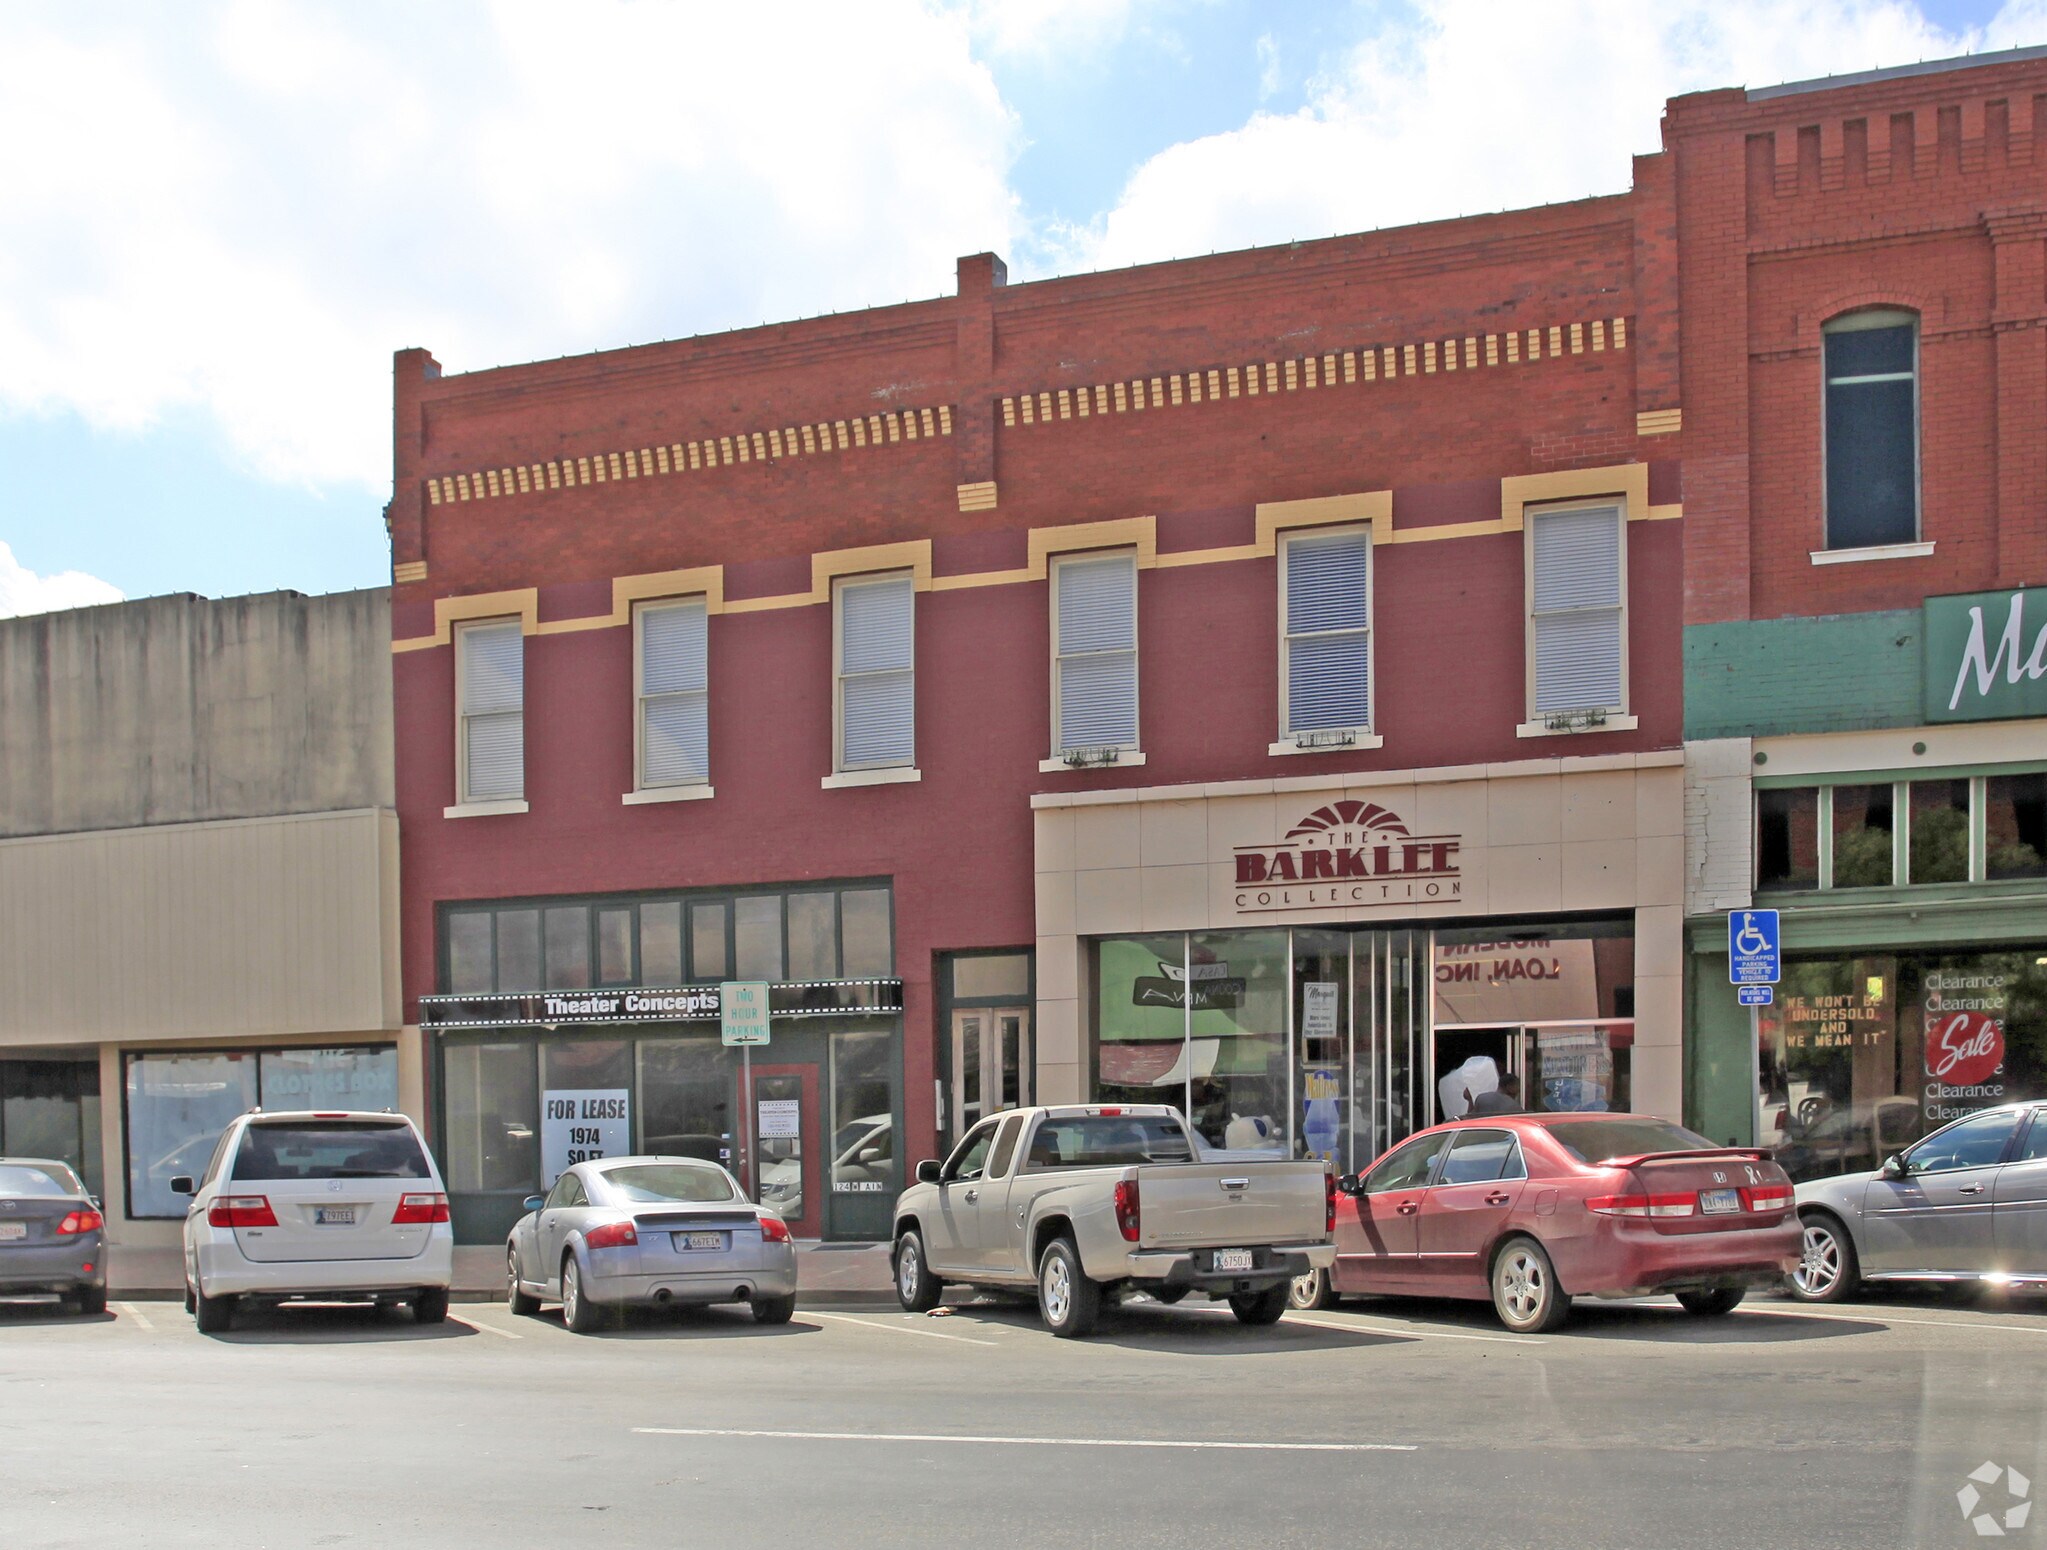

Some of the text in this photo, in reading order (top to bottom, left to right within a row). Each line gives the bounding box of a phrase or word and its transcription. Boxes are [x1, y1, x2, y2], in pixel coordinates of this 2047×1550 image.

[1328, 831, 1368, 845] THE
[1234, 842, 1460, 883] BARKLEE
[1235, 882, 1461, 907] COLLECTION
[1925, 974, 2004, 990] Clearance
[735, 990, 754, 1002] TWO
[1814, 994, 1854, 1008] WON'T
[544, 993, 719, 1015] Theater Concepts
[1925, 996, 2004, 1012] Clearance
[731, 1008, 758, 1020] HOUR
[1792, 1008, 1875, 1022] UNDERSOLD
[725, 1025, 766, 1037] PARKING
[1820, 1021, 1847, 1033] AND
[1787, 1035, 1805, 1047] WE
[1814, 1034, 1852, 1047] MEAN
[1936, 1014, 1996, 1076] Sale
[1925, 1083, 2004, 1099] Clearance
[547, 1099, 625, 1119] FOR LEASE
[569, 1127, 601, 1145] 1974
[834, 1183, 850, 1191] 124
